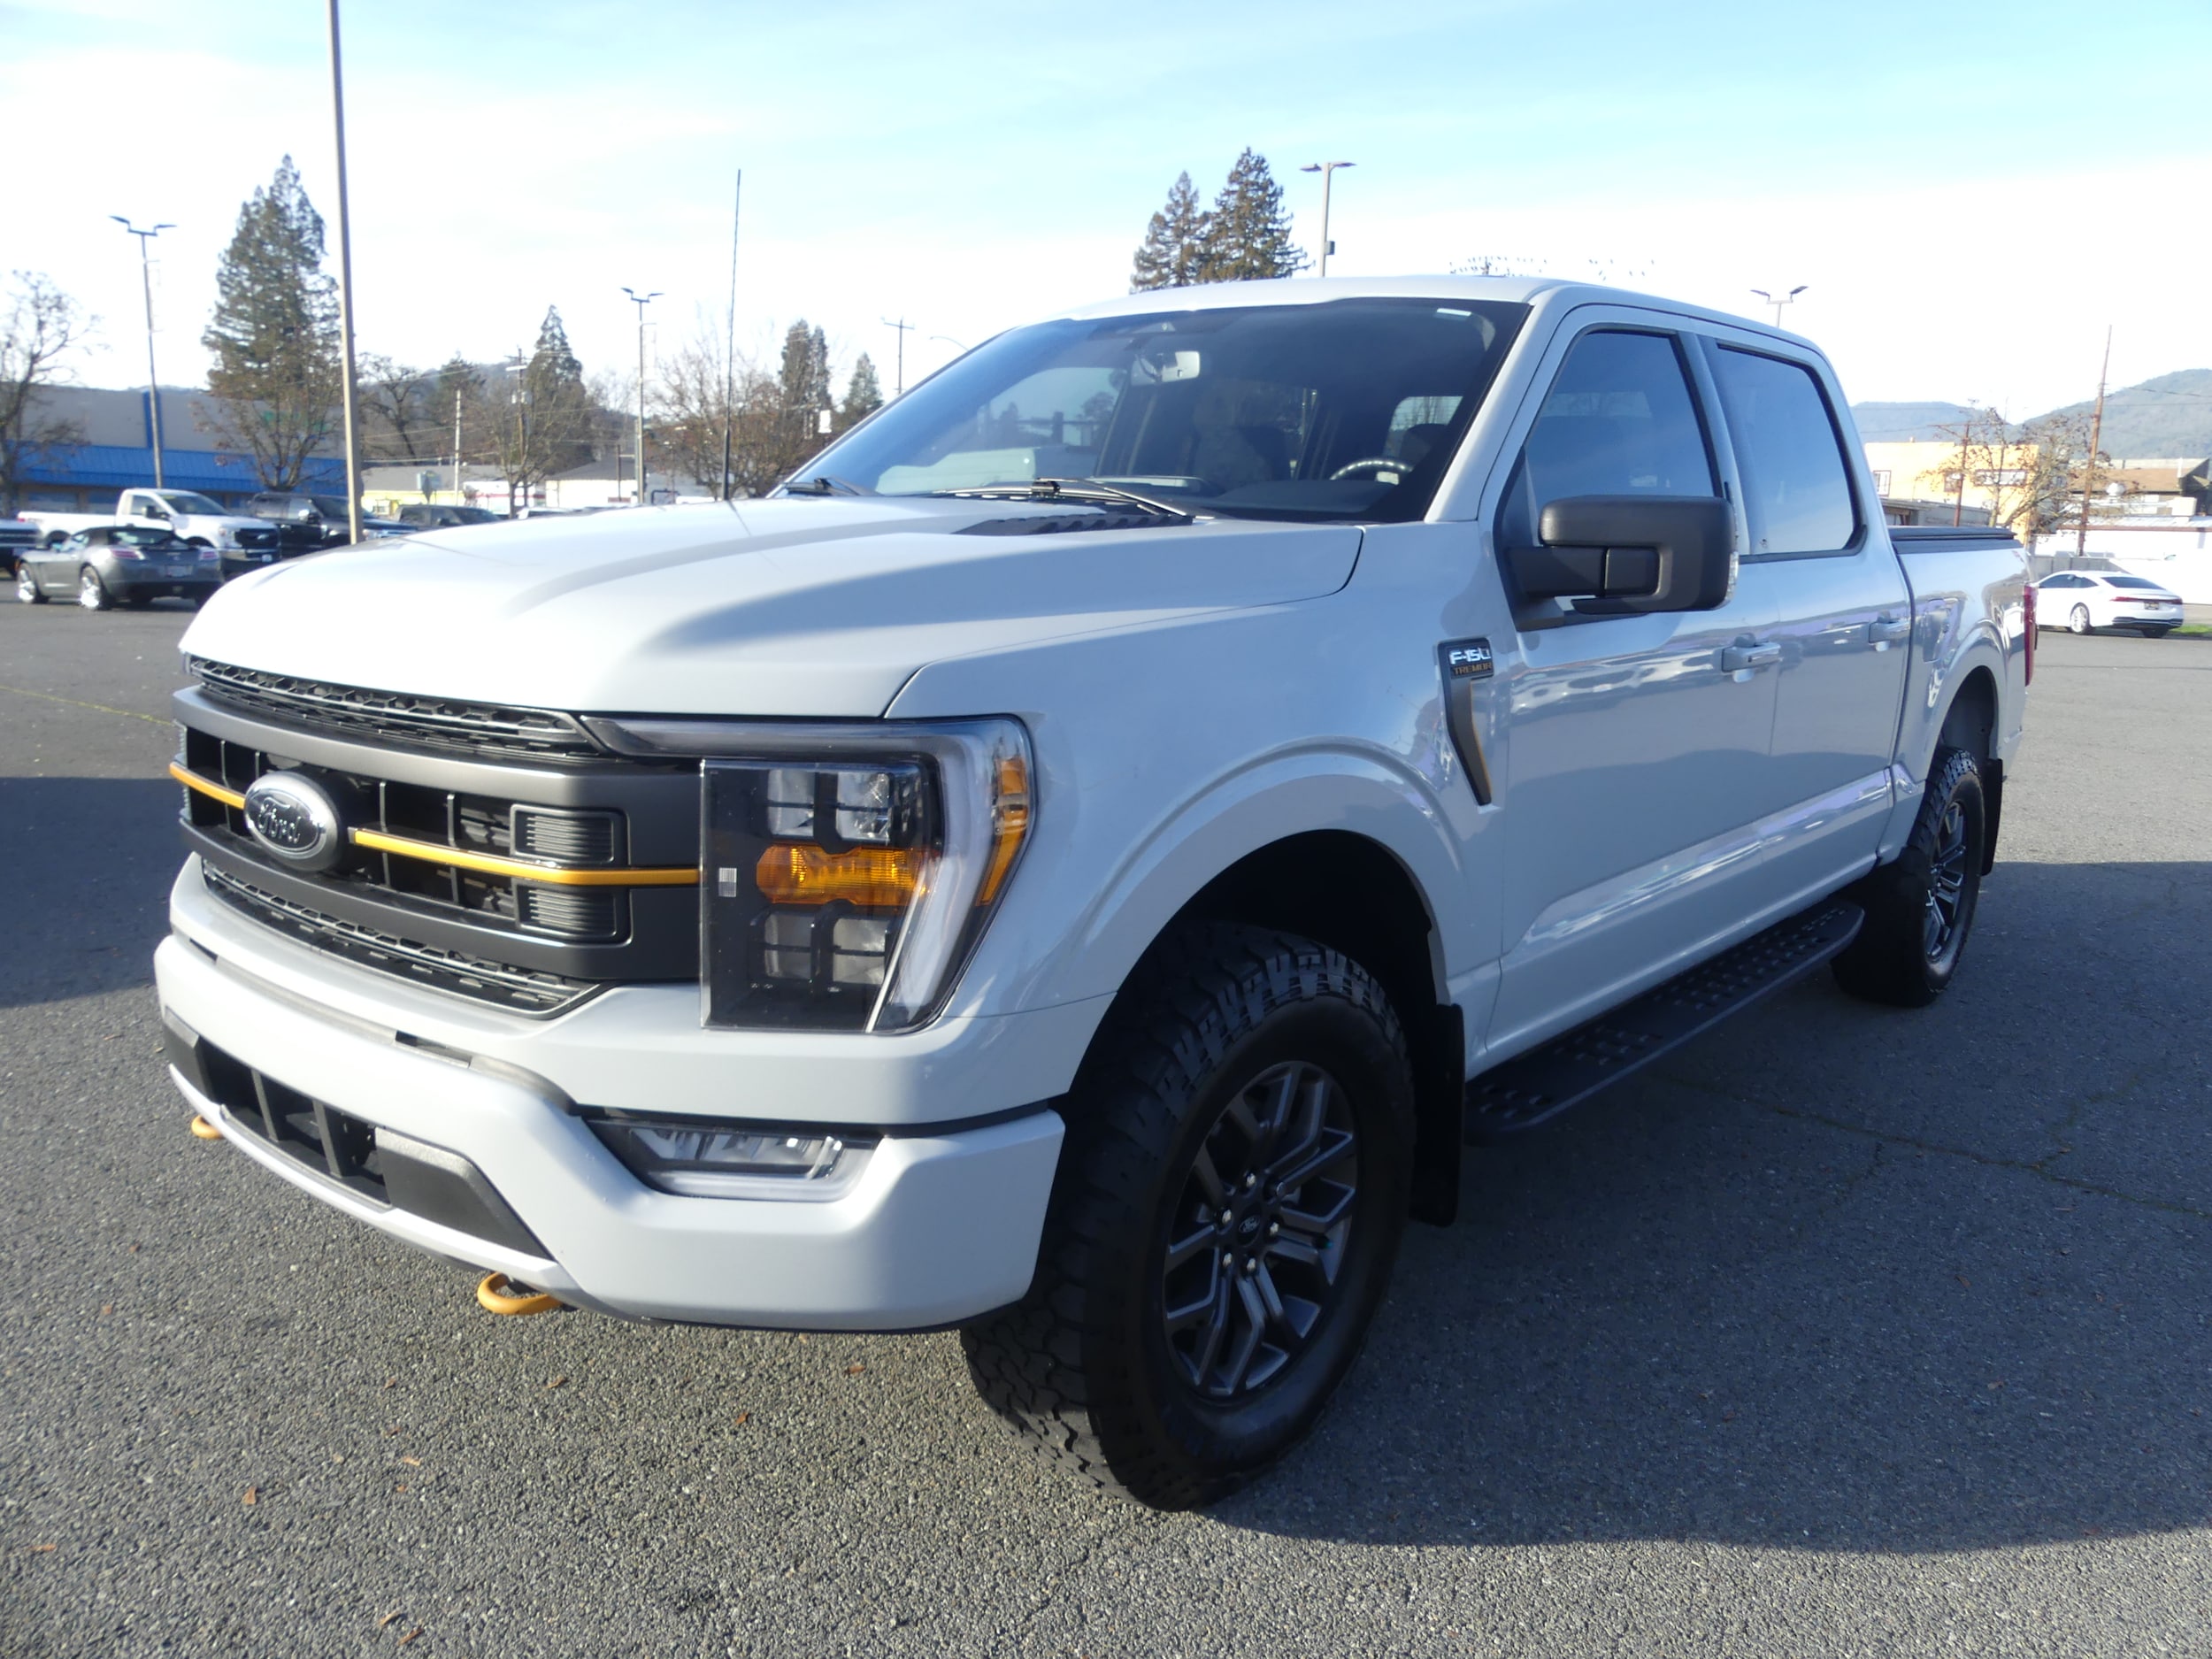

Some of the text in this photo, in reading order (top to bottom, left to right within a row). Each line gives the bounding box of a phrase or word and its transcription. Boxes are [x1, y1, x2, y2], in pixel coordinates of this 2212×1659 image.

[1449, 648, 1492, 664] F-150
[1454, 662, 1492, 674] TREMOR
[258, 796, 302, 843] Ford
